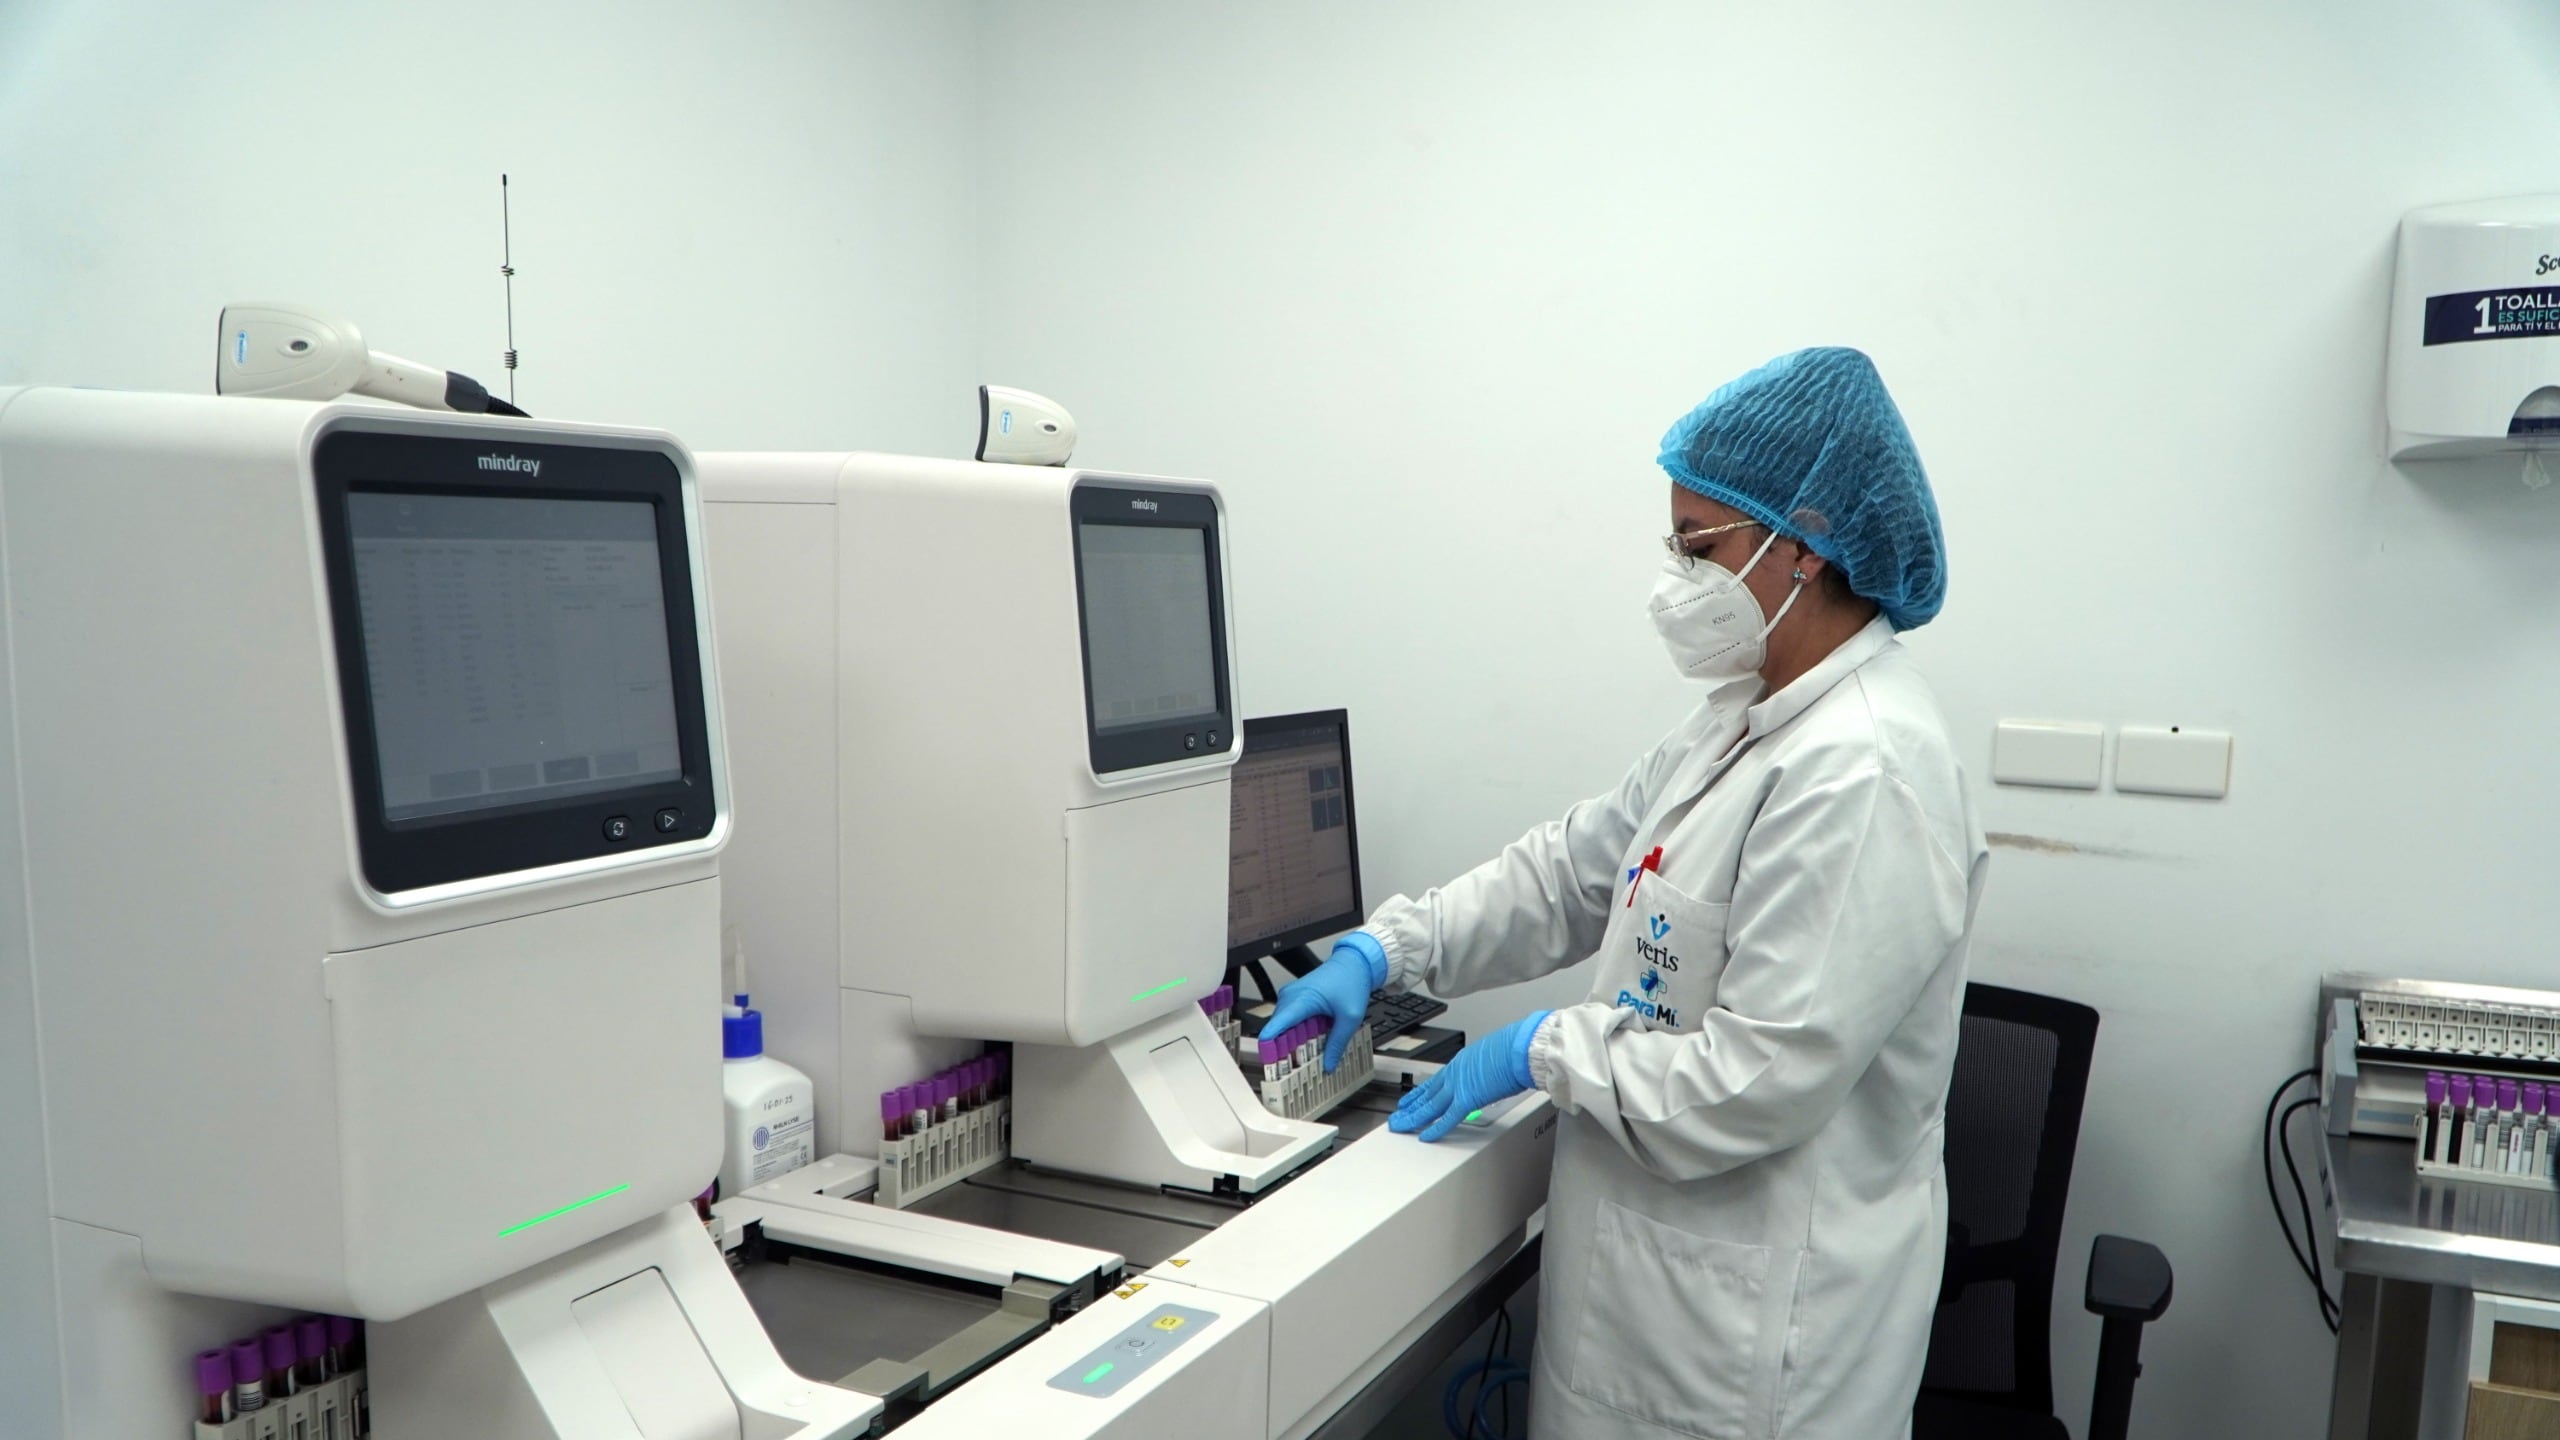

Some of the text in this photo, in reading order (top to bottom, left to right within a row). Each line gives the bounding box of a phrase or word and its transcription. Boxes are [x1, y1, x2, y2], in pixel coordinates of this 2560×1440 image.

[2474, 293, 2560, 334] 1 TOALL
[2498, 311, 2514, 323] ES
[2498, 322, 2523, 332] PARA
[2536, 321, 2543, 330] Y
[2545, 321, 2556, 330] EL
[477, 453, 541, 478] mindray
[1131, 498, 1158, 514] mindray
[1636, 936, 1680, 972] veris
